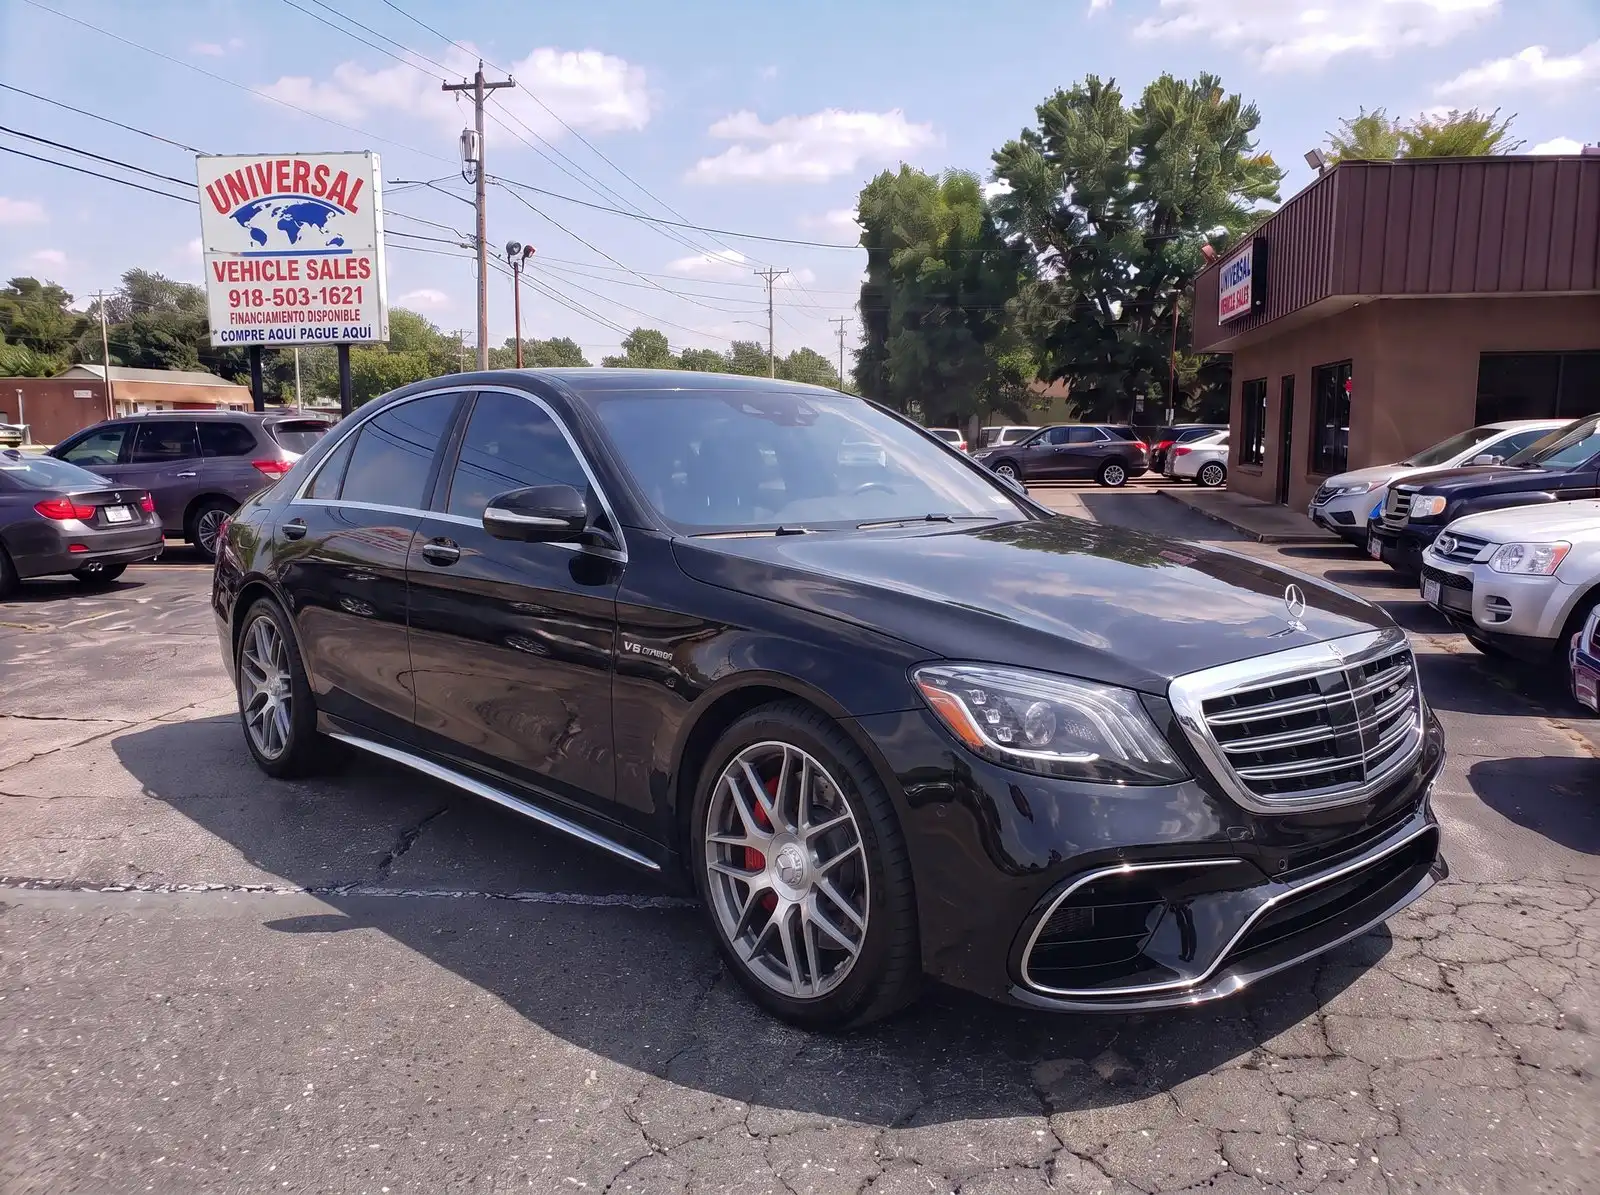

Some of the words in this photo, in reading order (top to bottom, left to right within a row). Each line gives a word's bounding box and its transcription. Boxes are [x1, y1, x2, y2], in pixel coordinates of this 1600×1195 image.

[206, 160, 364, 215] UNIVERSAL
[212, 260, 300, 282] VEHICLE
[306, 258, 371, 281] SALES
[228, 286, 364, 308] 918-503-1621
[230, 310, 305, 325] FINANCIAMIENTO
[307, 309, 361, 323] DISPONIBLE
[221, 328, 265, 342] COMPRE
[268, 326, 296, 341] AQUÍ
[300, 327, 339, 339] PAGUE
[342, 324, 372, 339] AQUÍ
